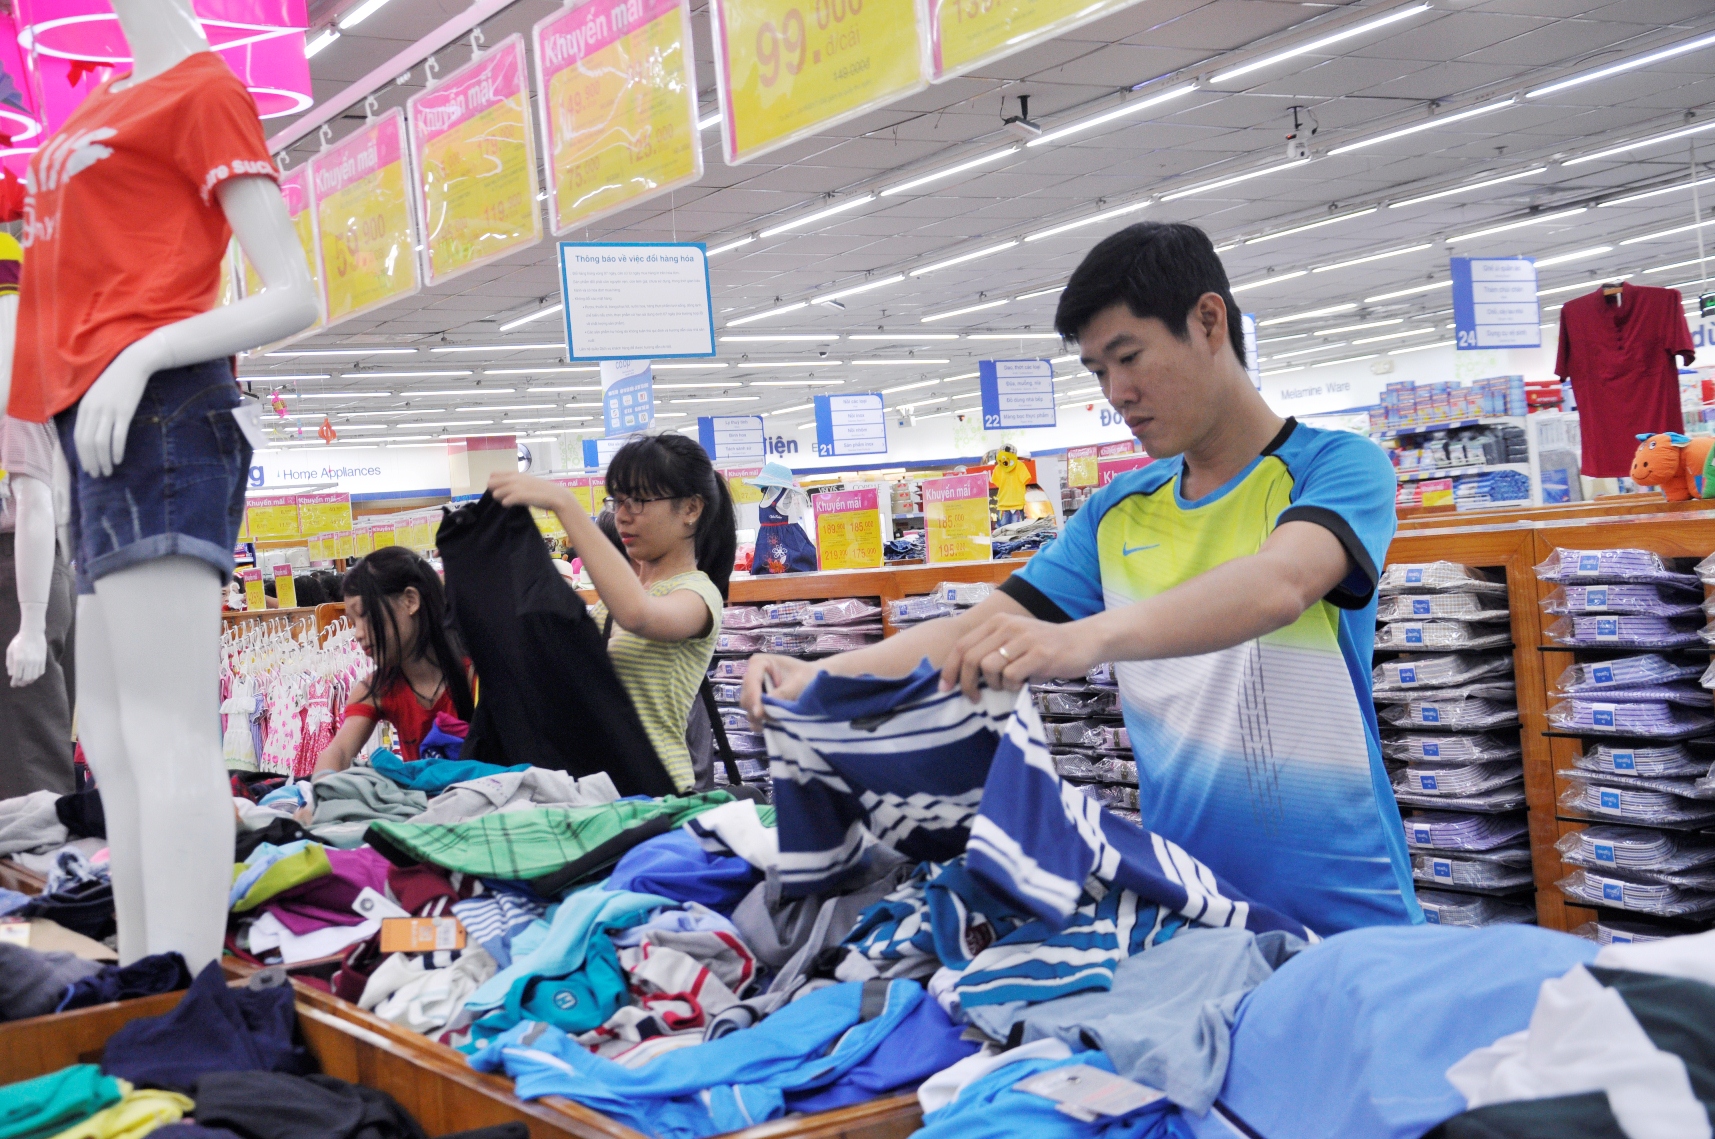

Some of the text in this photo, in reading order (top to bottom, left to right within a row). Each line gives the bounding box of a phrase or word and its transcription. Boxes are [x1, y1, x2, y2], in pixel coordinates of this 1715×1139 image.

[544, 6, 609, 68] Khuyến
[315, 141, 379, 194] Khuyến mãi
[575, 254, 600, 265] Thông
[601, 254, 617, 263] báo
[618, 252, 628, 263] về
[629, 253, 645, 265] việc
[660, 254, 679, 265] hàng
[680, 253, 695, 263] hóa
[1458, 330, 1476, 346] 24
[1281, 381, 1351, 400] Melamine Ware
[985, 414, 1000, 427] 22
[820, 443, 833, 456] 21
[283, 465, 381, 480] Home Appliances
[925, 483, 971, 502] Khuyến mãi
[246, 498, 285, 507] Khuyến mãi
[816, 495, 862, 514] Khuyến mãi
